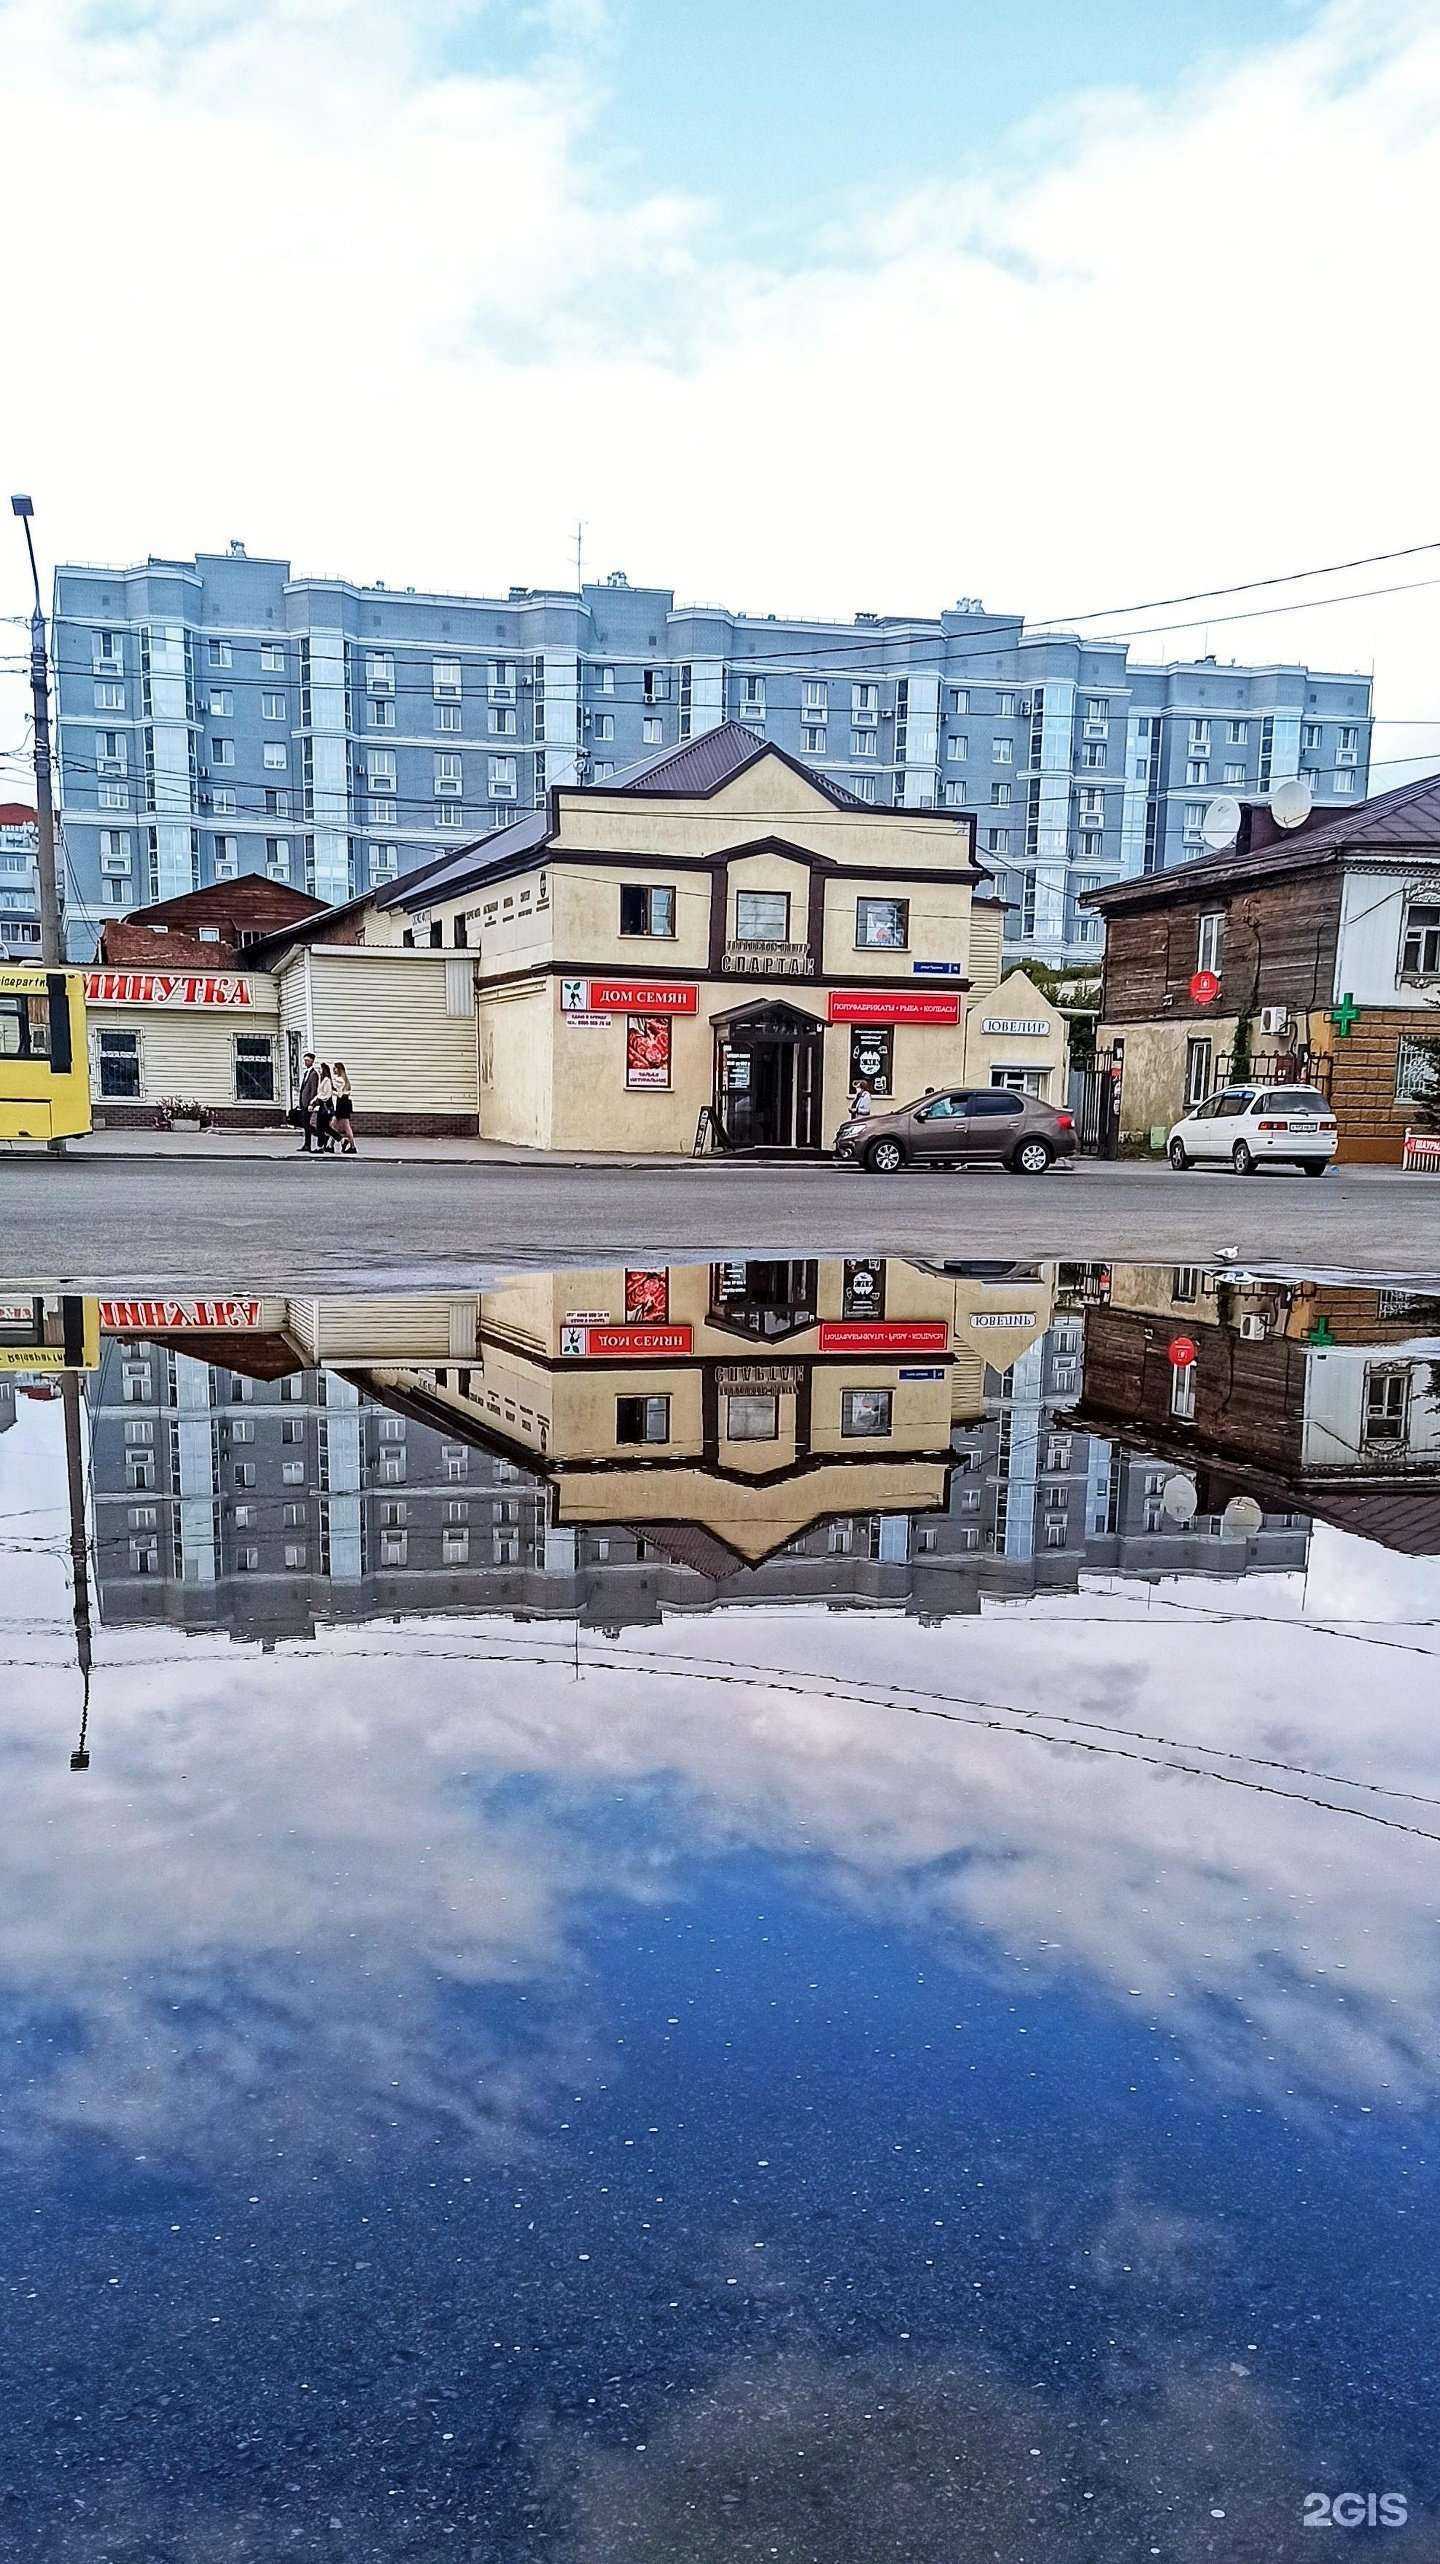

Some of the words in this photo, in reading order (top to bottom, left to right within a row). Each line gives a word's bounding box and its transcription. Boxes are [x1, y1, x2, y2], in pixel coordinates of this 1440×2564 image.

[722, 955, 815, 976] СПАРТАК
[600, 990, 632, 1002] ДОМ
[636, 991, 687, 1004] СЕМЯН
[833, 1003, 896, 1012] ПОЛУФАБРИКАТЫ
[899, 1004, 919, 1012] РЫБА
[923, 1005, 957, 1013] КОЛБАСЫ
[988, 1020, 1045, 1033] ЮВЕЛИР
